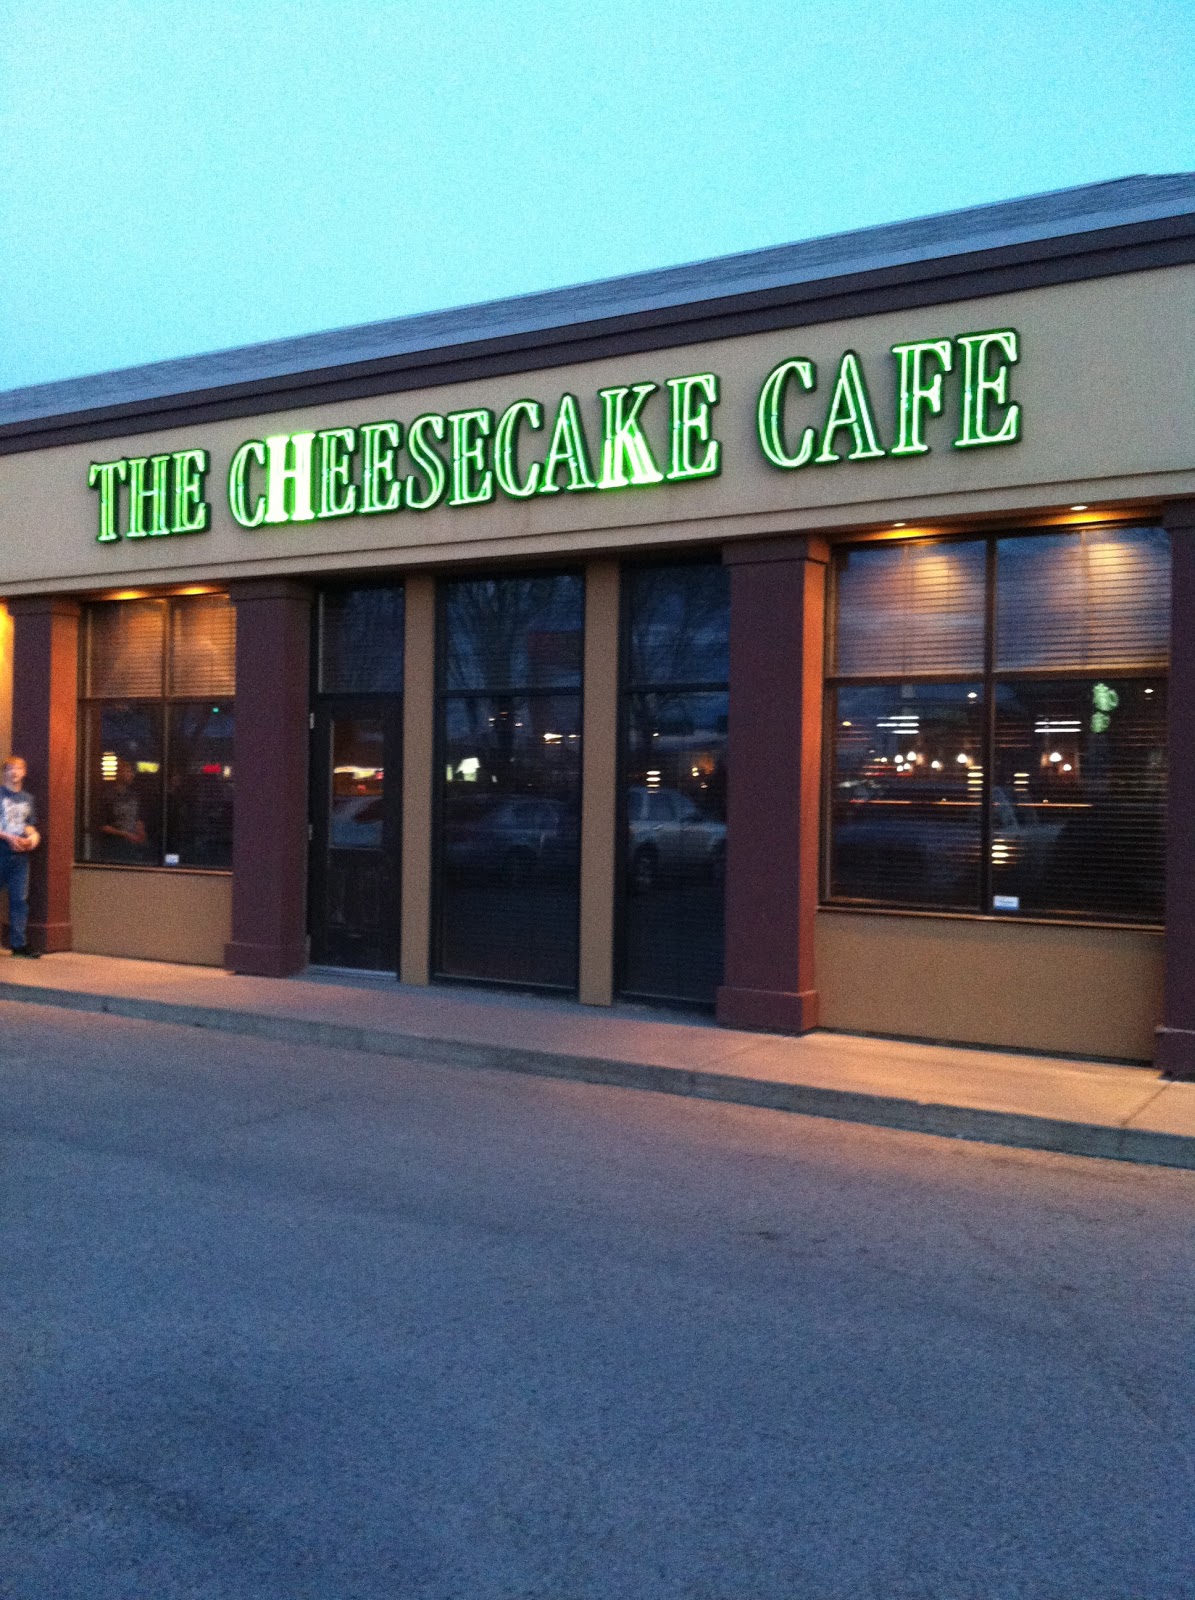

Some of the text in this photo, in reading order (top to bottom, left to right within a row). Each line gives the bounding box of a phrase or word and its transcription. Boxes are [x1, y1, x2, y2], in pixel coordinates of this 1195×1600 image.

[88, 327, 1021, 544] THE CHEESECAKE CAFE
